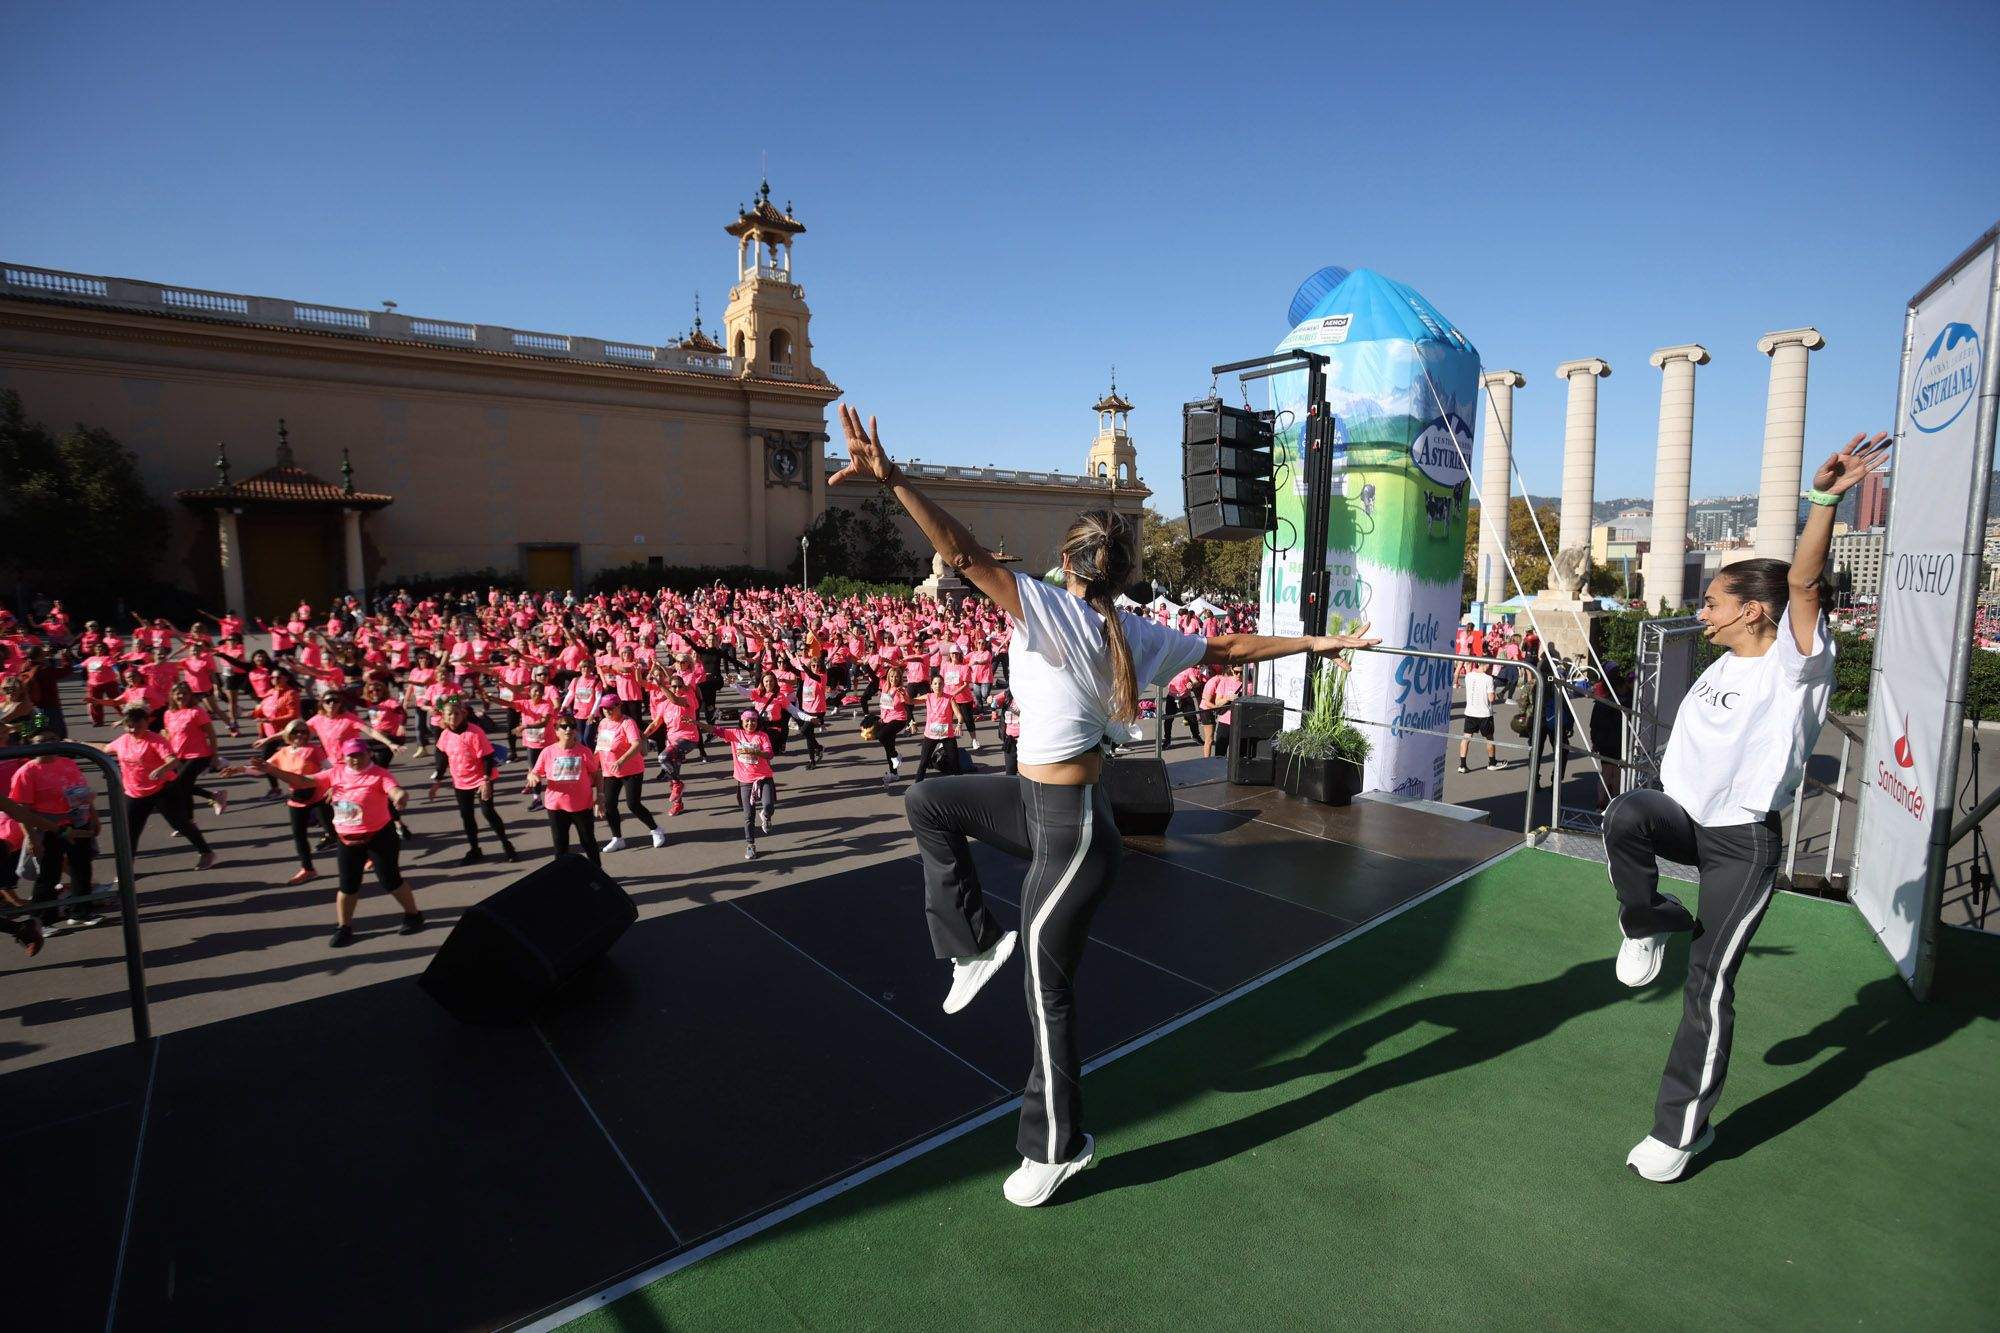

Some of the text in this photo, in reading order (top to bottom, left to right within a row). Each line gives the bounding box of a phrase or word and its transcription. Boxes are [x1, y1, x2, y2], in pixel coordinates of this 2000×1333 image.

[1913, 361, 1974, 415] ASTURIANA
[1896, 553, 1954, 596] OYSHO
[1877, 760, 1925, 822] Santander
